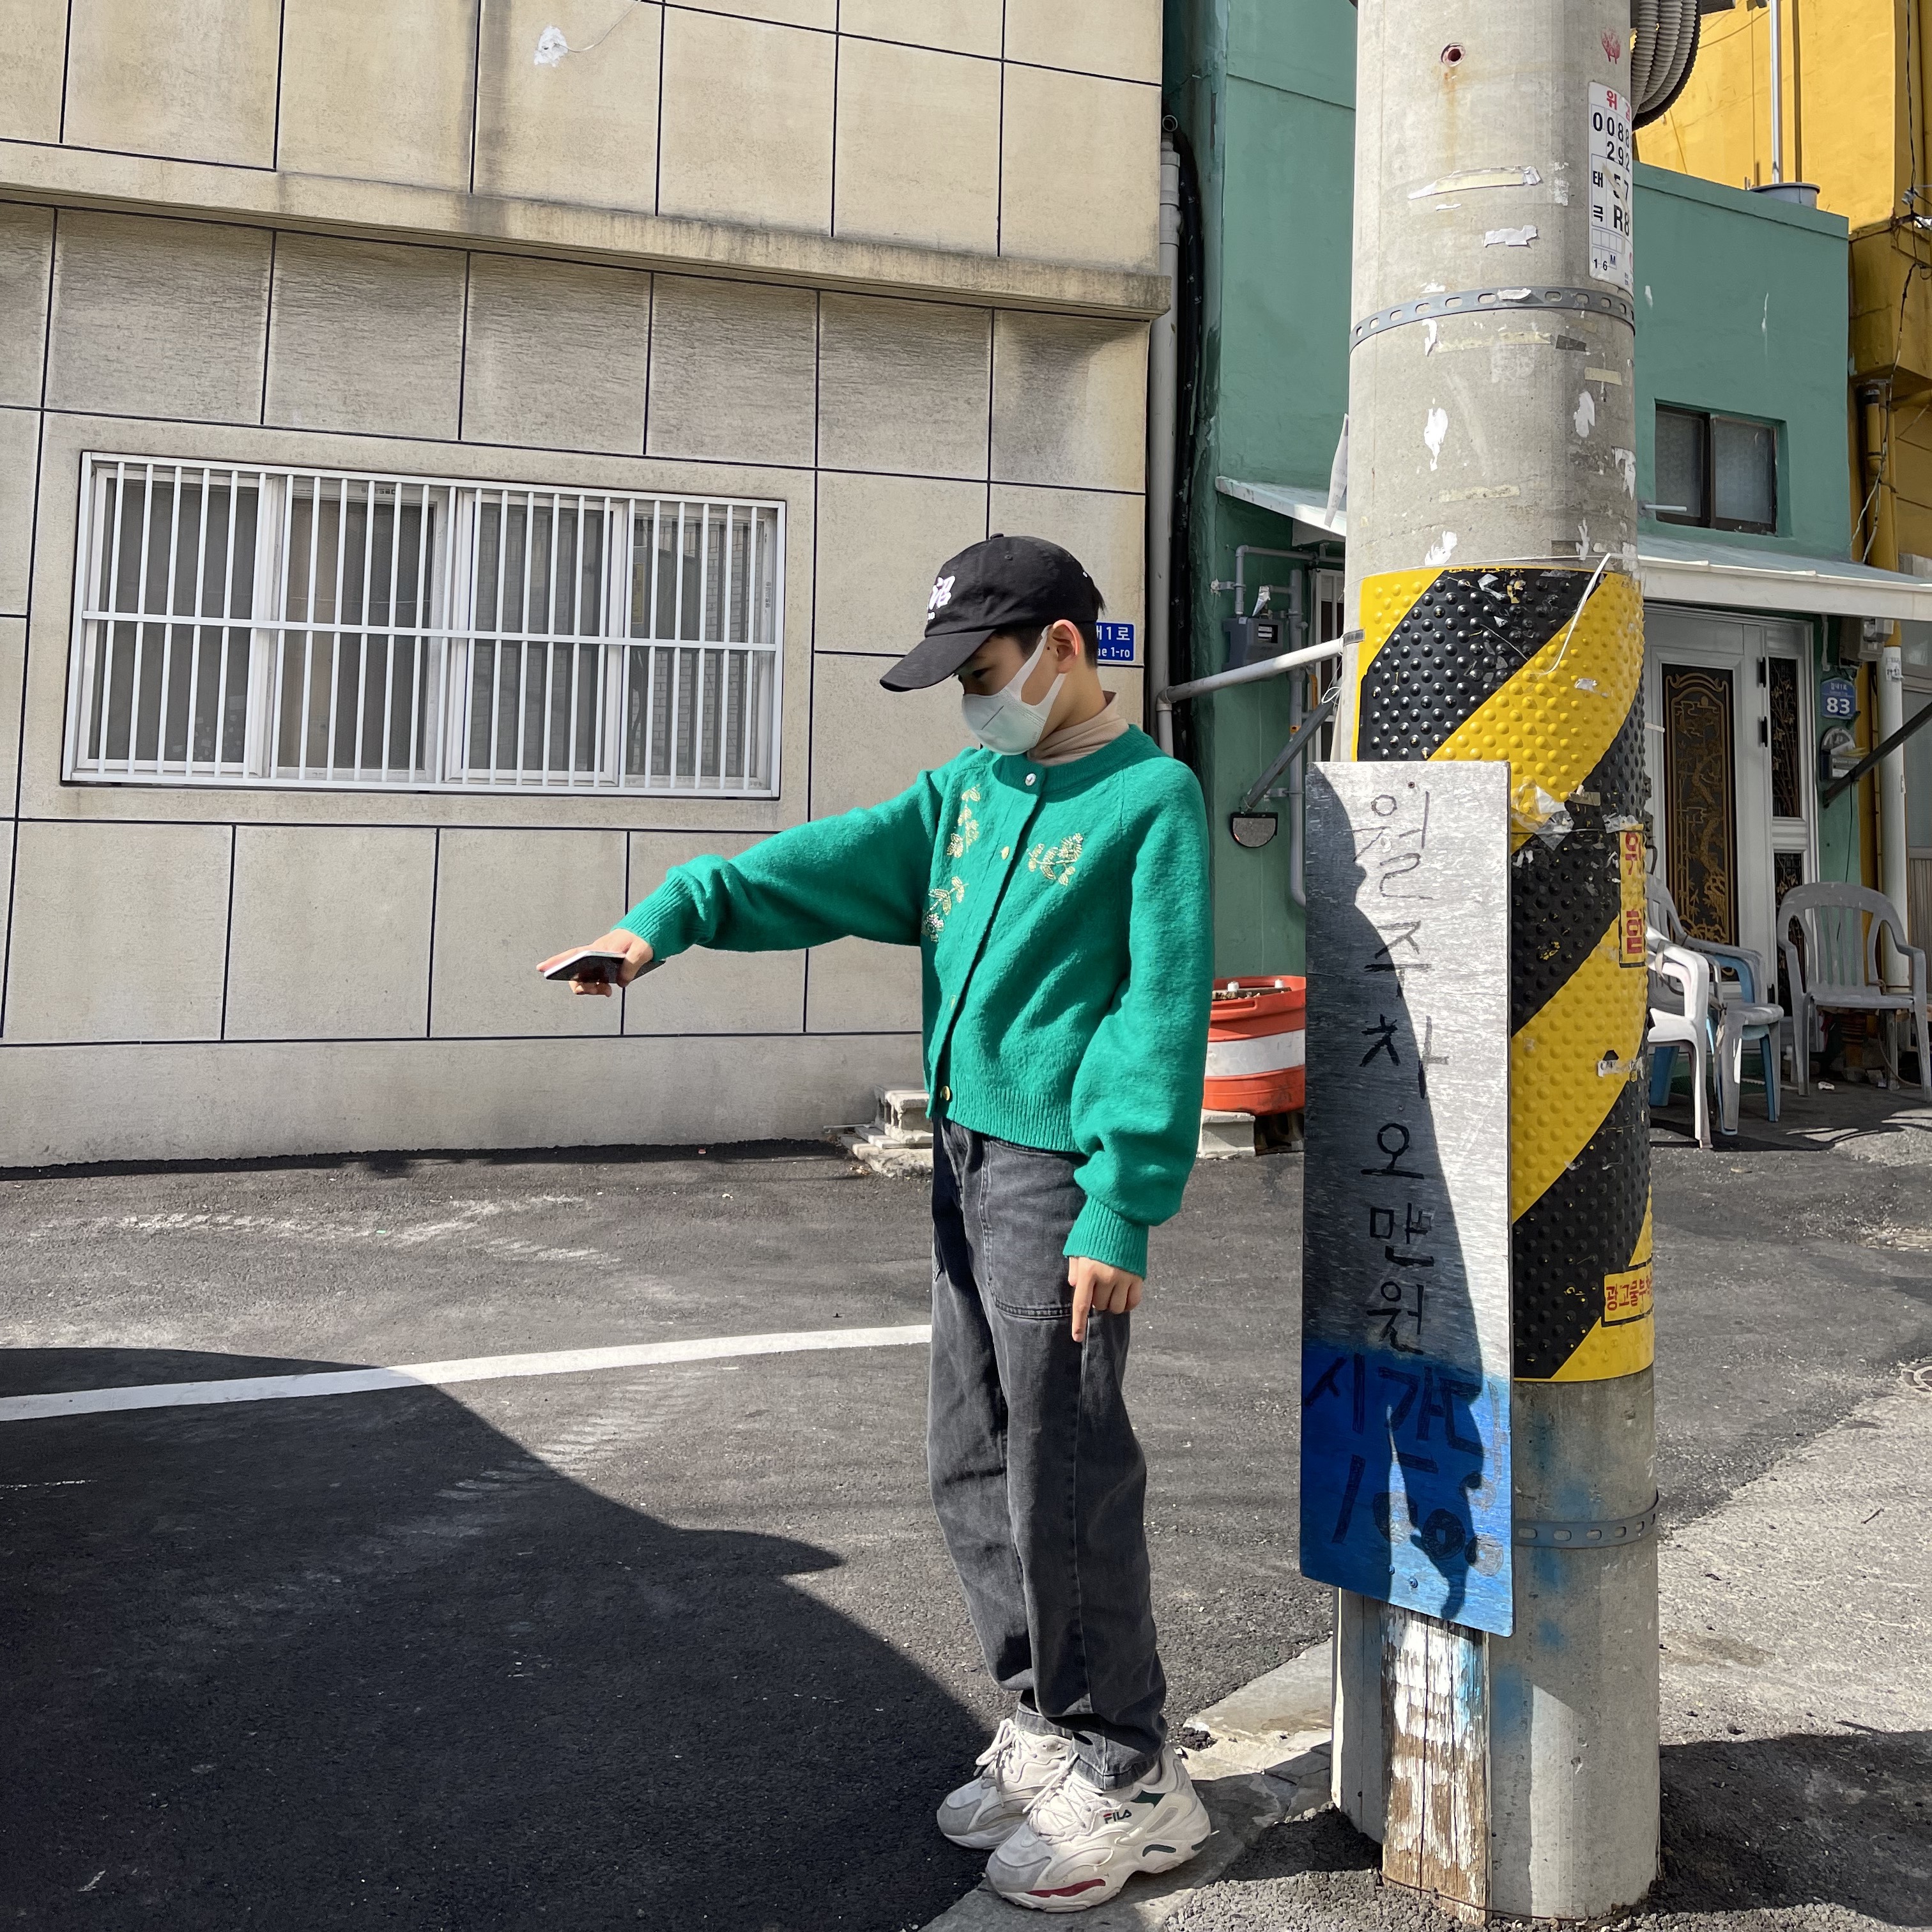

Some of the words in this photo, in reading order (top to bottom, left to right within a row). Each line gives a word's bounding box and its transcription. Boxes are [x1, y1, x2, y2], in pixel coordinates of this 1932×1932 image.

[1111, 647, 1130, 658] 1-ro
[1827, 696, 1850, 715] 83
[1103, 1809, 1133, 1824] FILA
